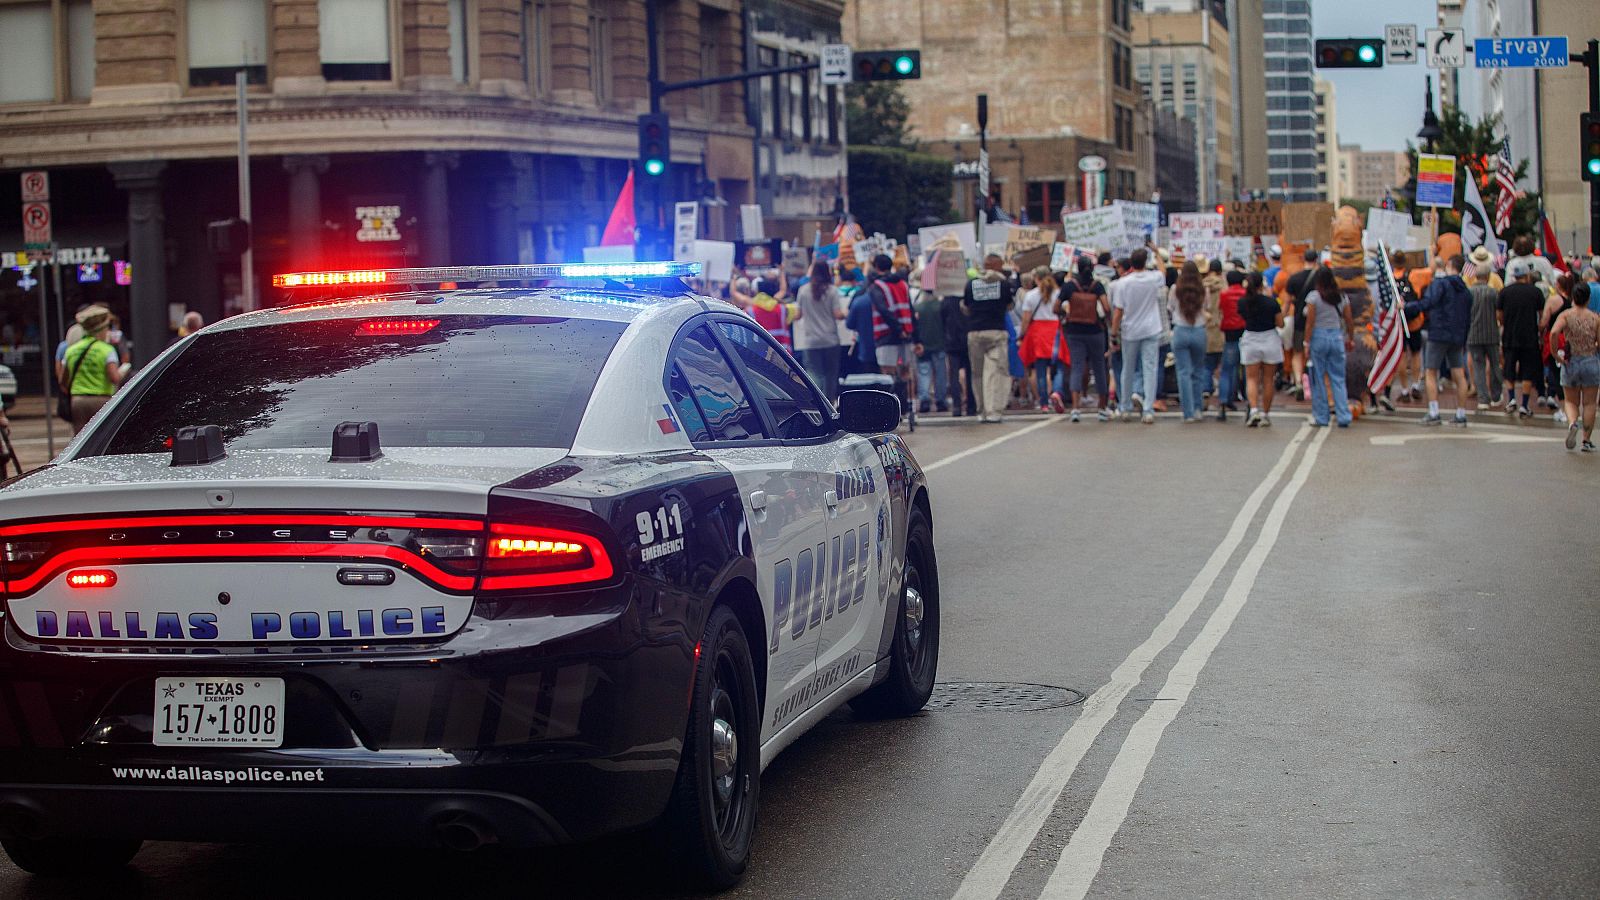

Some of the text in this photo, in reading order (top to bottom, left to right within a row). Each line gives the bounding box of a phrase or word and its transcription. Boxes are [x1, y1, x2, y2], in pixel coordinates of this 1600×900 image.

[1390, 28, 1411, 37] ONE
[825, 47, 847, 56] ONE
[1492, 39, 1551, 58] Ervay
[825, 58, 847, 66] WAY
[1432, 55, 1457, 65] ONLY
[1479, 56, 1565, 67] 100 N 200 N
[355, 206, 401, 219] PRESS
[1231, 200, 1270, 213] USA
[355, 229, 402, 242] GRILL
[48, 247, 110, 265] RILL
[109, 529, 348, 541] DODGE
[640, 537, 685, 563] EMERGENCY
[770, 522, 871, 656] POLICE
[35, 606, 447, 640] DALLAS POLICE
[195, 682, 245, 696] TEXAS
[771, 682, 812, 728] SERVING
[813, 665, 841, 696] SINCE
[162, 704, 277, 736] 157 1808
[112, 766, 325, 784] www.dallaspolice.net
